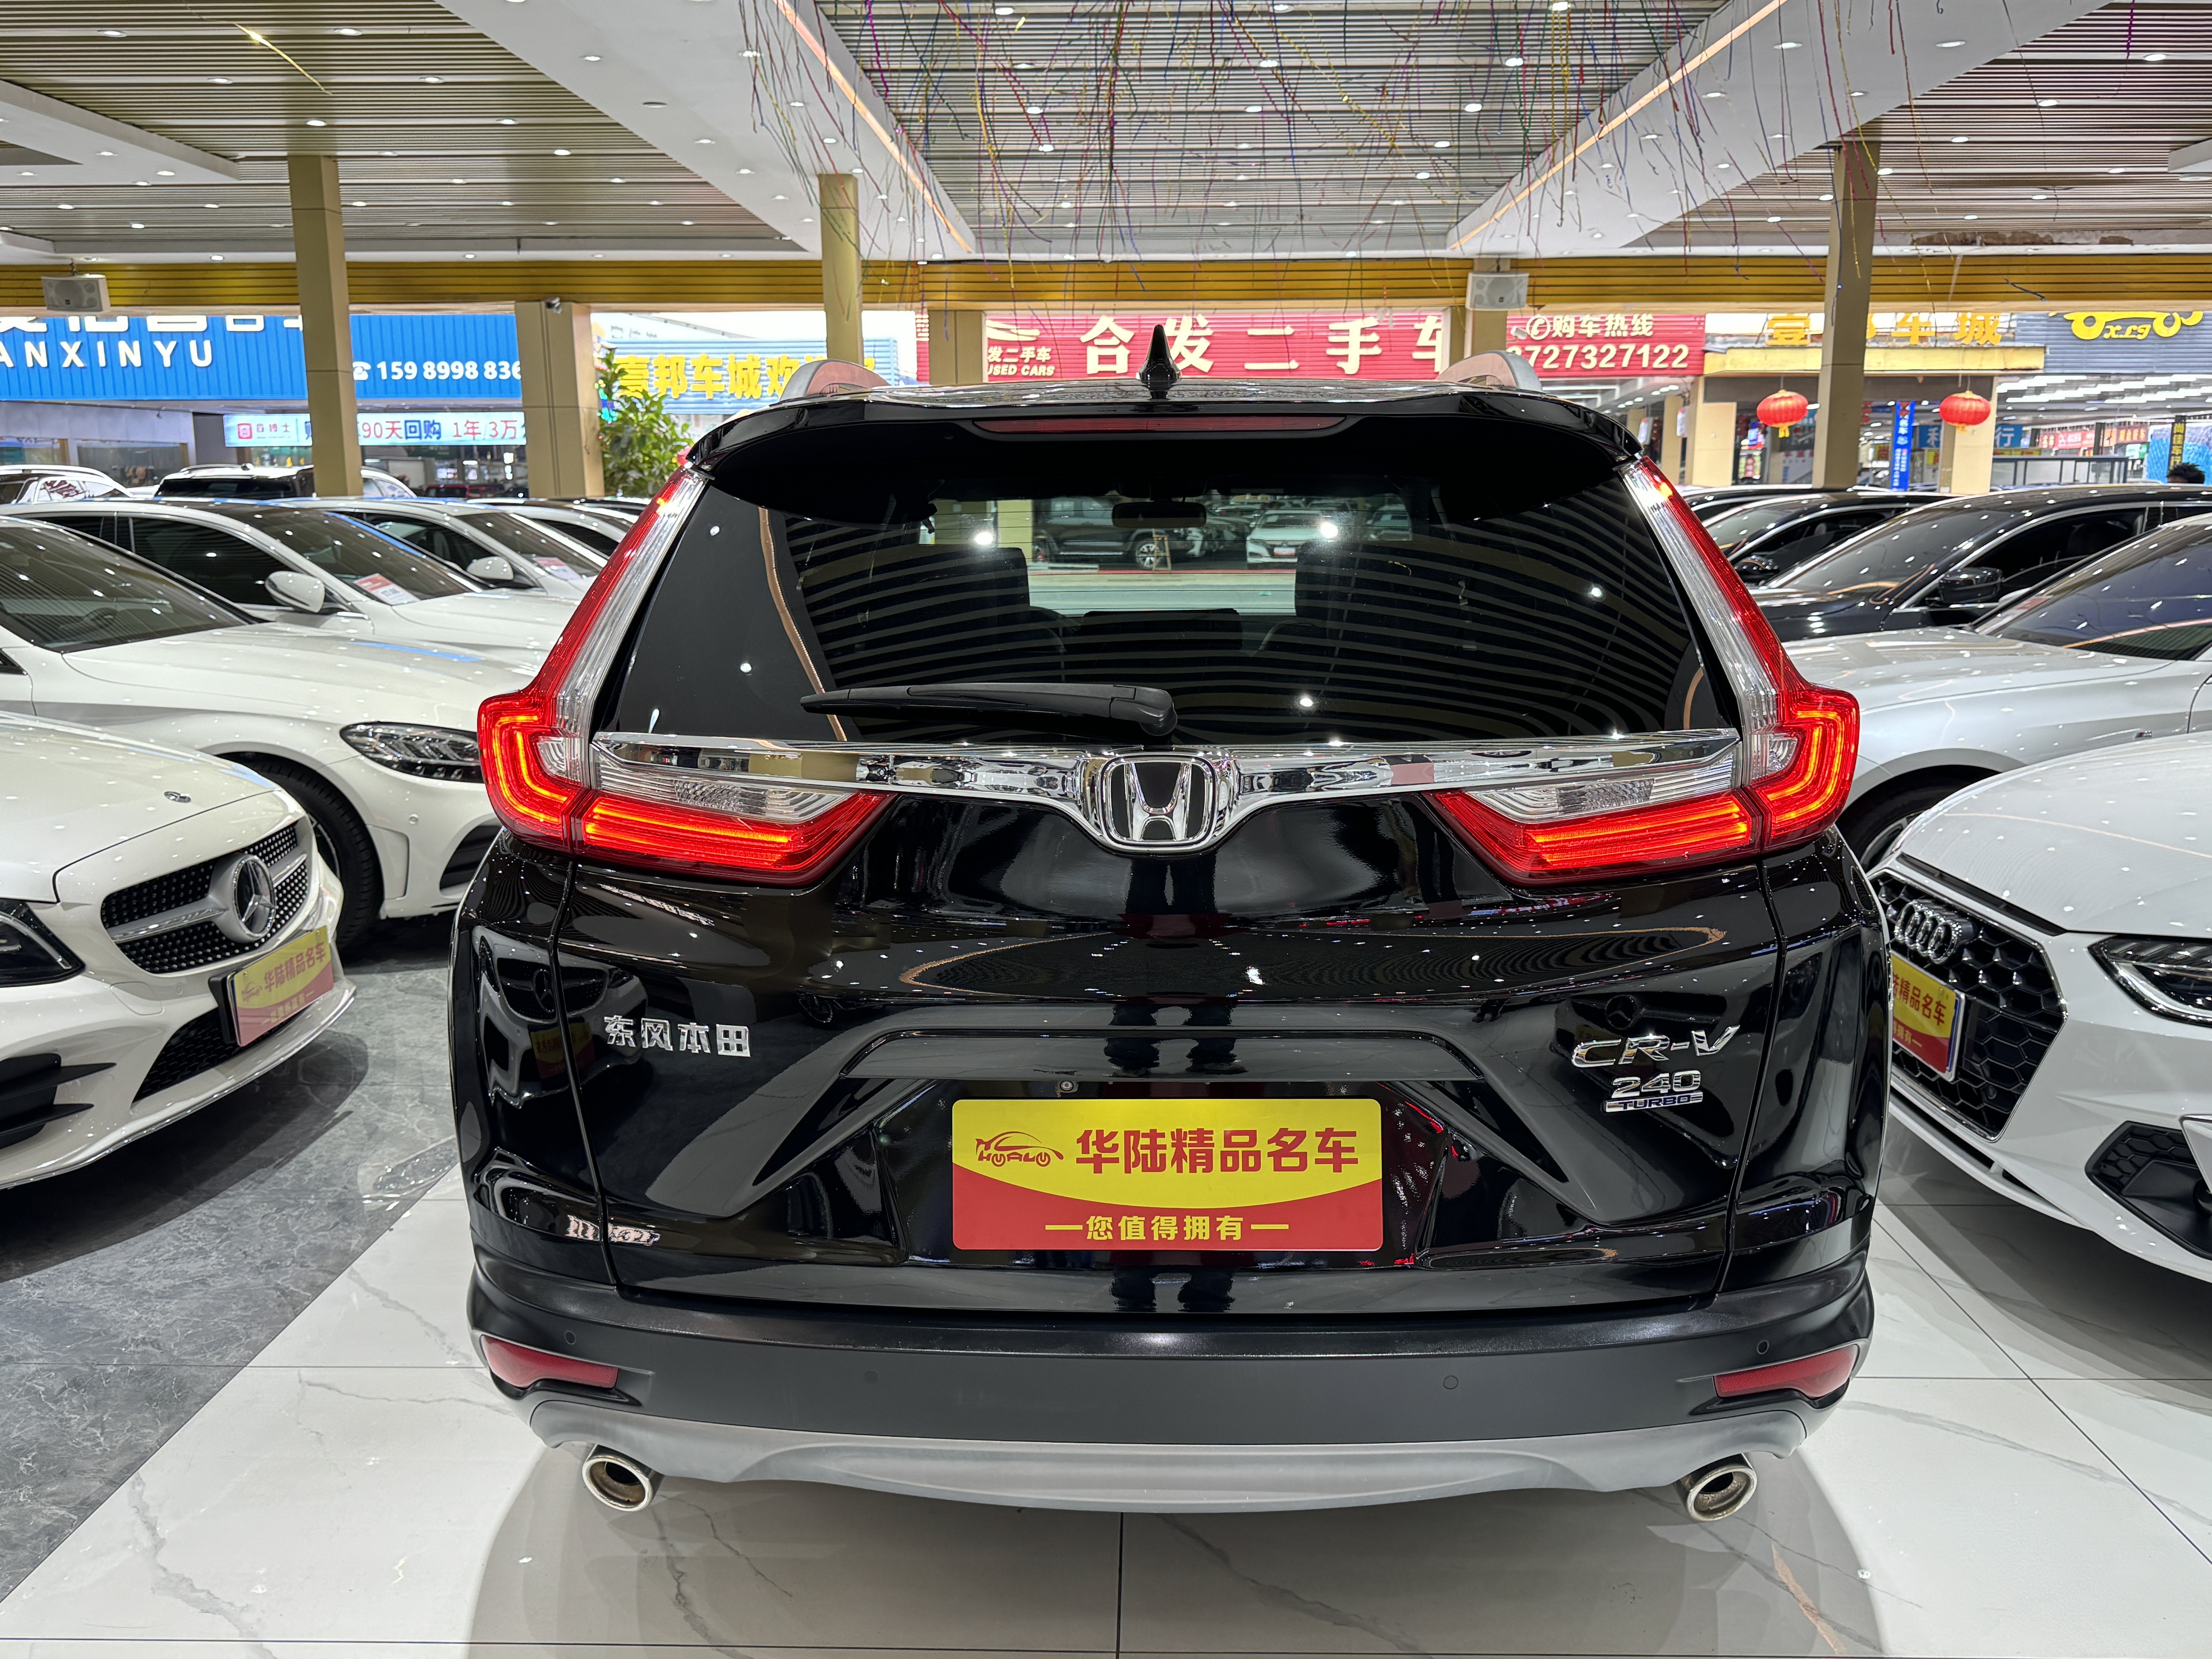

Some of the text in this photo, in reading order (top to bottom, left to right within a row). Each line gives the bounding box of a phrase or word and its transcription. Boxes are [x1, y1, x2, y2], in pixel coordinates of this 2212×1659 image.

[1551, 314, 1654, 338] 购车热线
[987, 345, 1052, 363] 发二手车
[376, 361, 418, 380] 159
[422, 361, 479, 380] 8998
[1020, 364, 1056, 376] CARS
[361, 419, 441, 440] 90天回购
[604, 1015, 751, 1058] 东风本田
[1571, 1024, 1741, 1068] CR-V
[1611, 1070, 1701, 1099] 240
[1617, 1094, 1691, 1110] TURBO
[1075, 1127, 1359, 1174] 华陆精品名车
[1086, 1215, 1244, 1241] 您值得拥有
